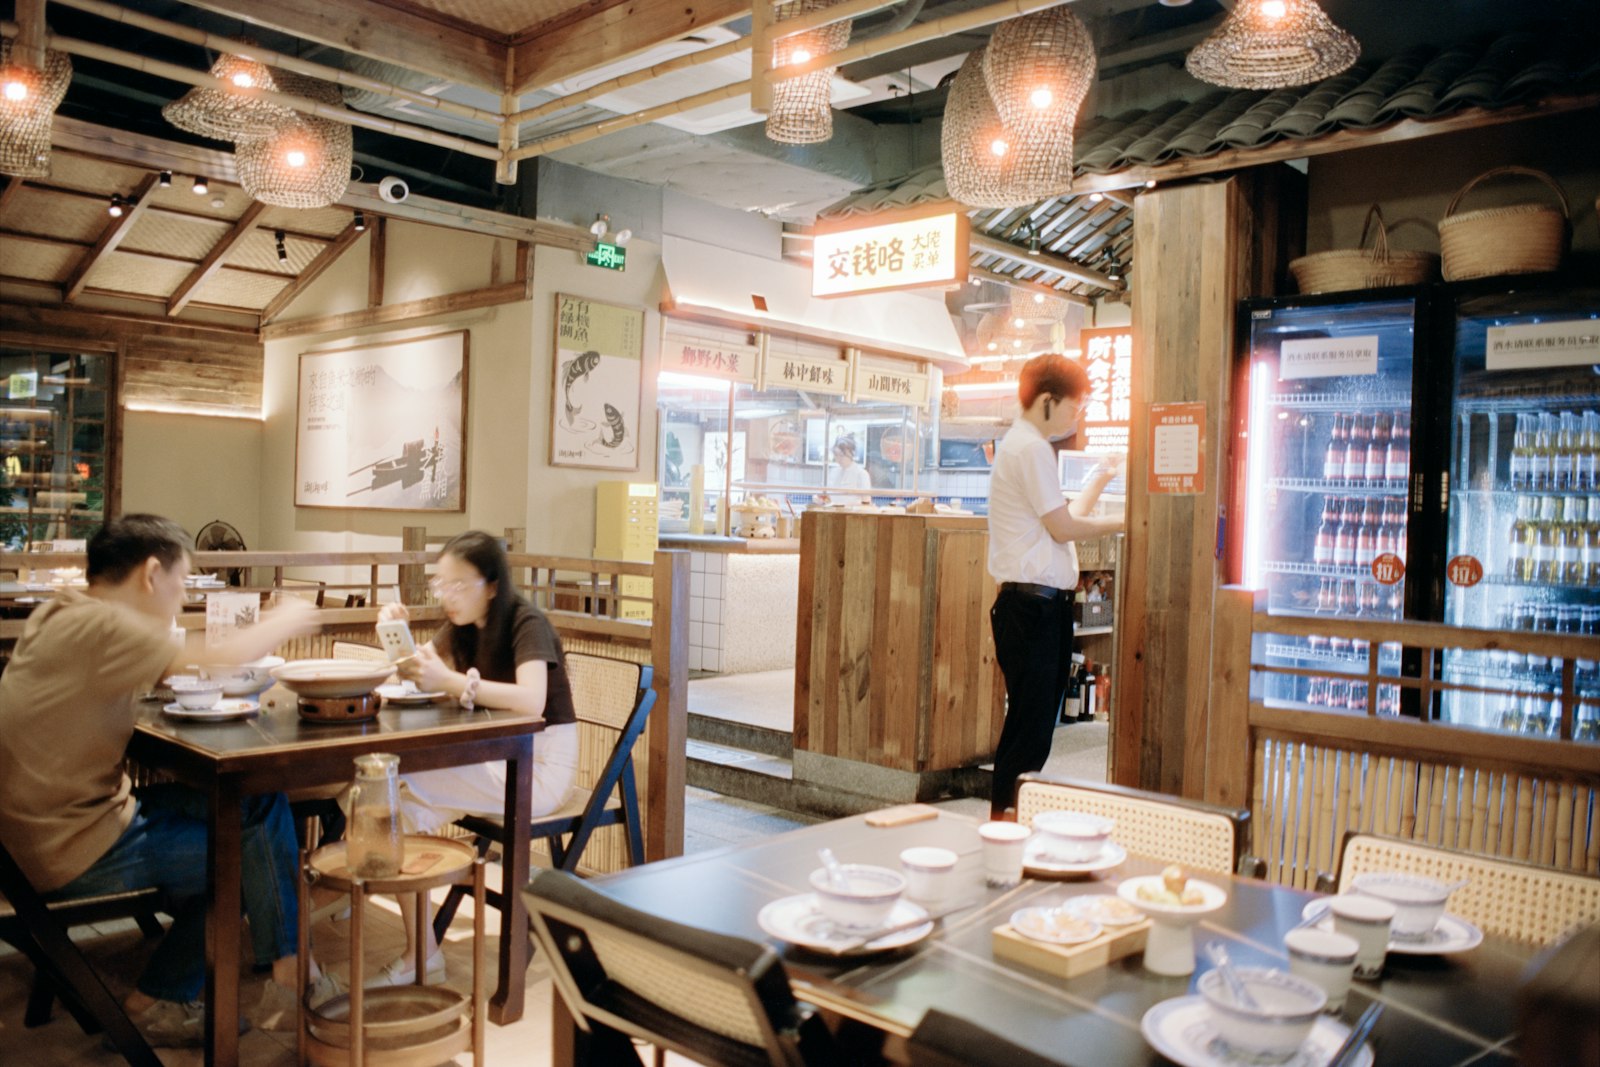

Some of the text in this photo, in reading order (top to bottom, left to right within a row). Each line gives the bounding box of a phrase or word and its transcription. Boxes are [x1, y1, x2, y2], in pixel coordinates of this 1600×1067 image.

[911, 231, 941, 250] 大佬
[828, 237, 905, 280] 交钱咯
[912, 251, 941, 269] 买单
[783, 361, 834, 384] 林中鮮味
[868, 374, 912, 395] 山間野味
